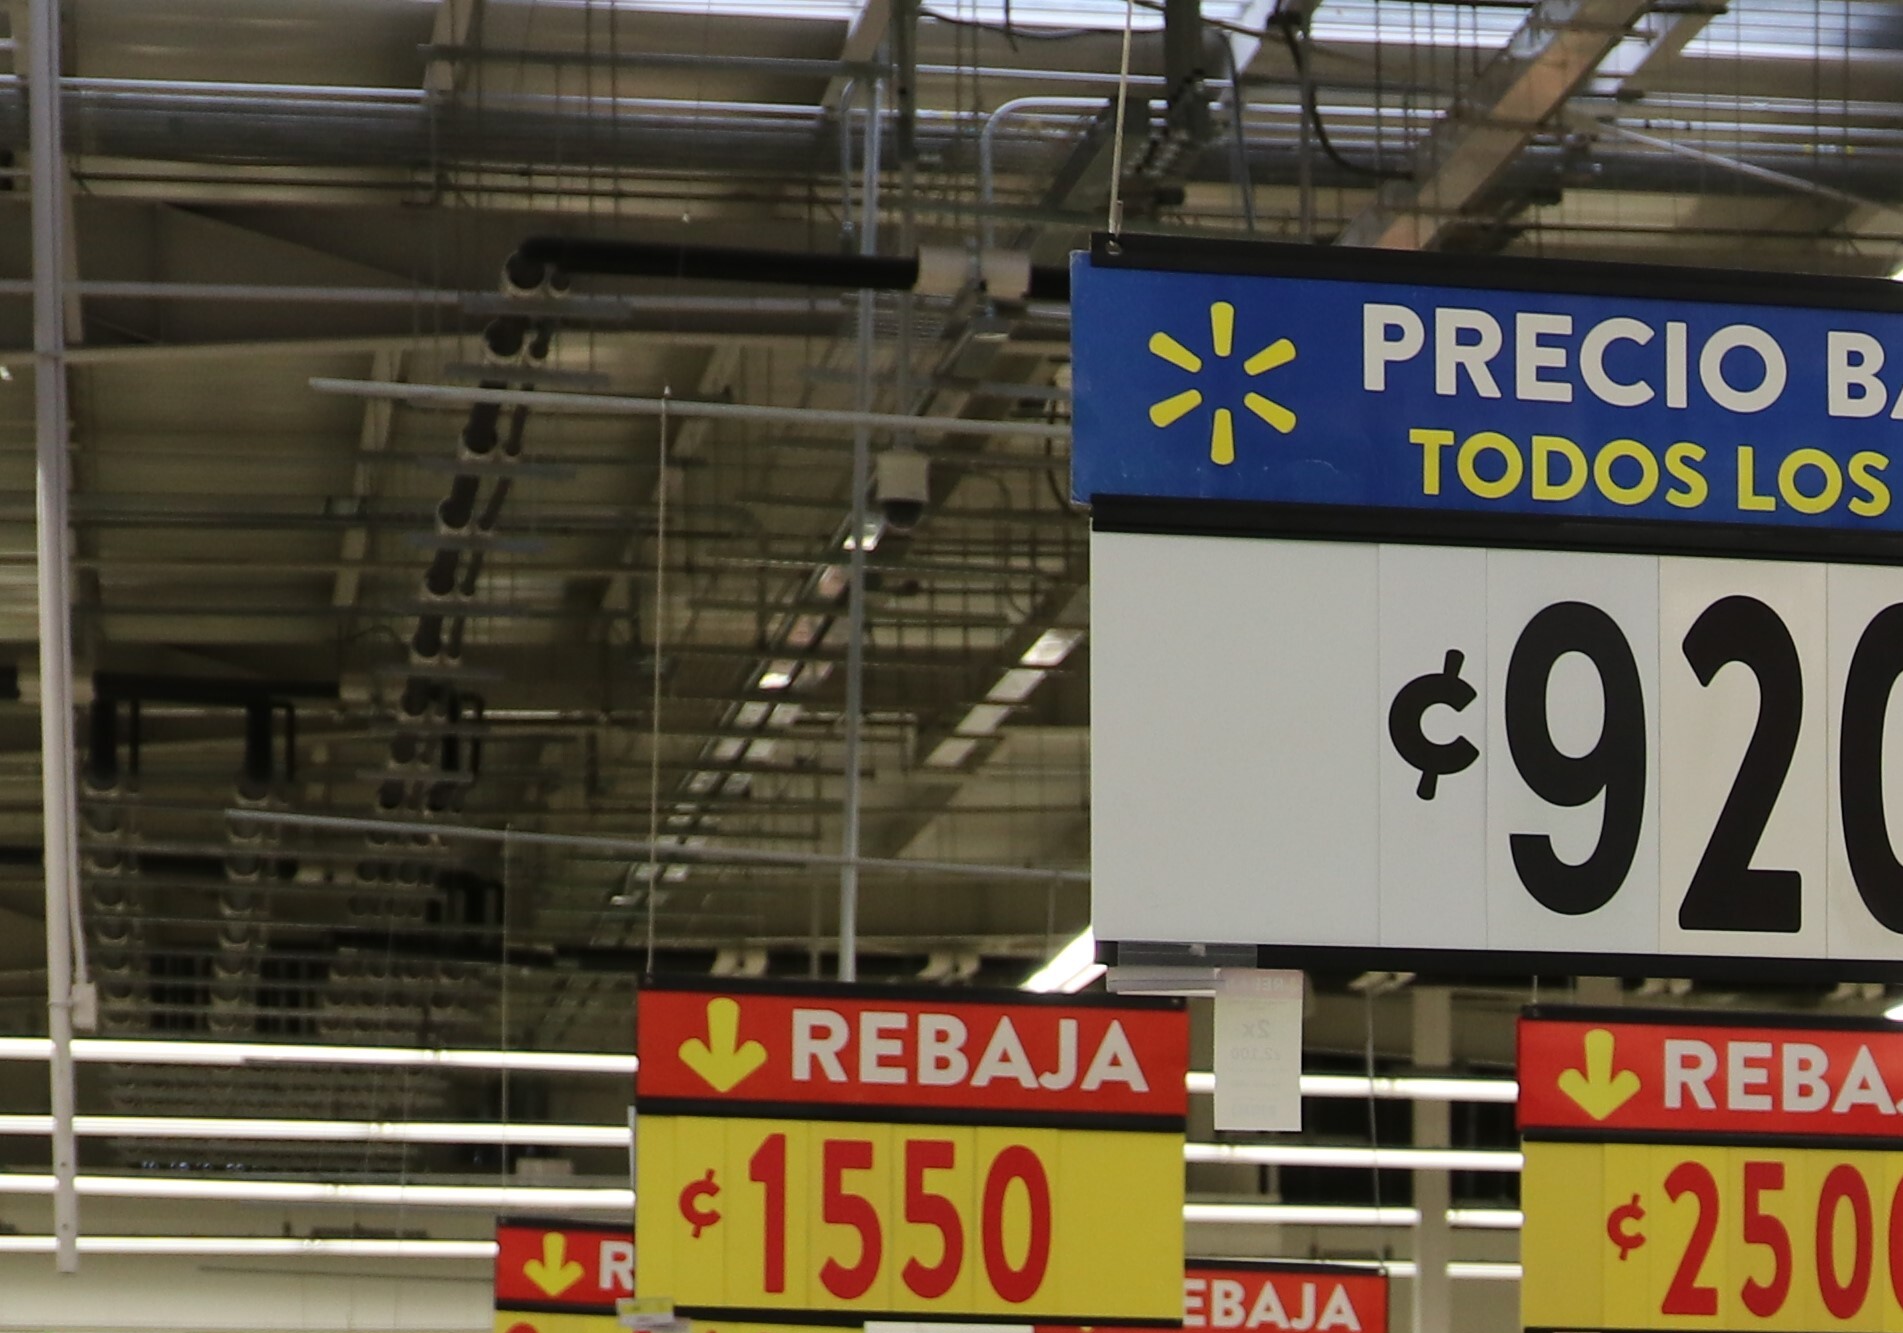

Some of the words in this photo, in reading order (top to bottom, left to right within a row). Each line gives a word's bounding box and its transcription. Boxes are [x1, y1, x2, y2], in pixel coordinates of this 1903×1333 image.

[1363, 304, 1787, 412] PRECIO
[1408, 428, 1708, 509] TODOS
[1737, 447, 1891, 518] LOS
[791, 1008, 1149, 1092] REBAJA
[1184, 1278, 1361, 1333] EBAJA
